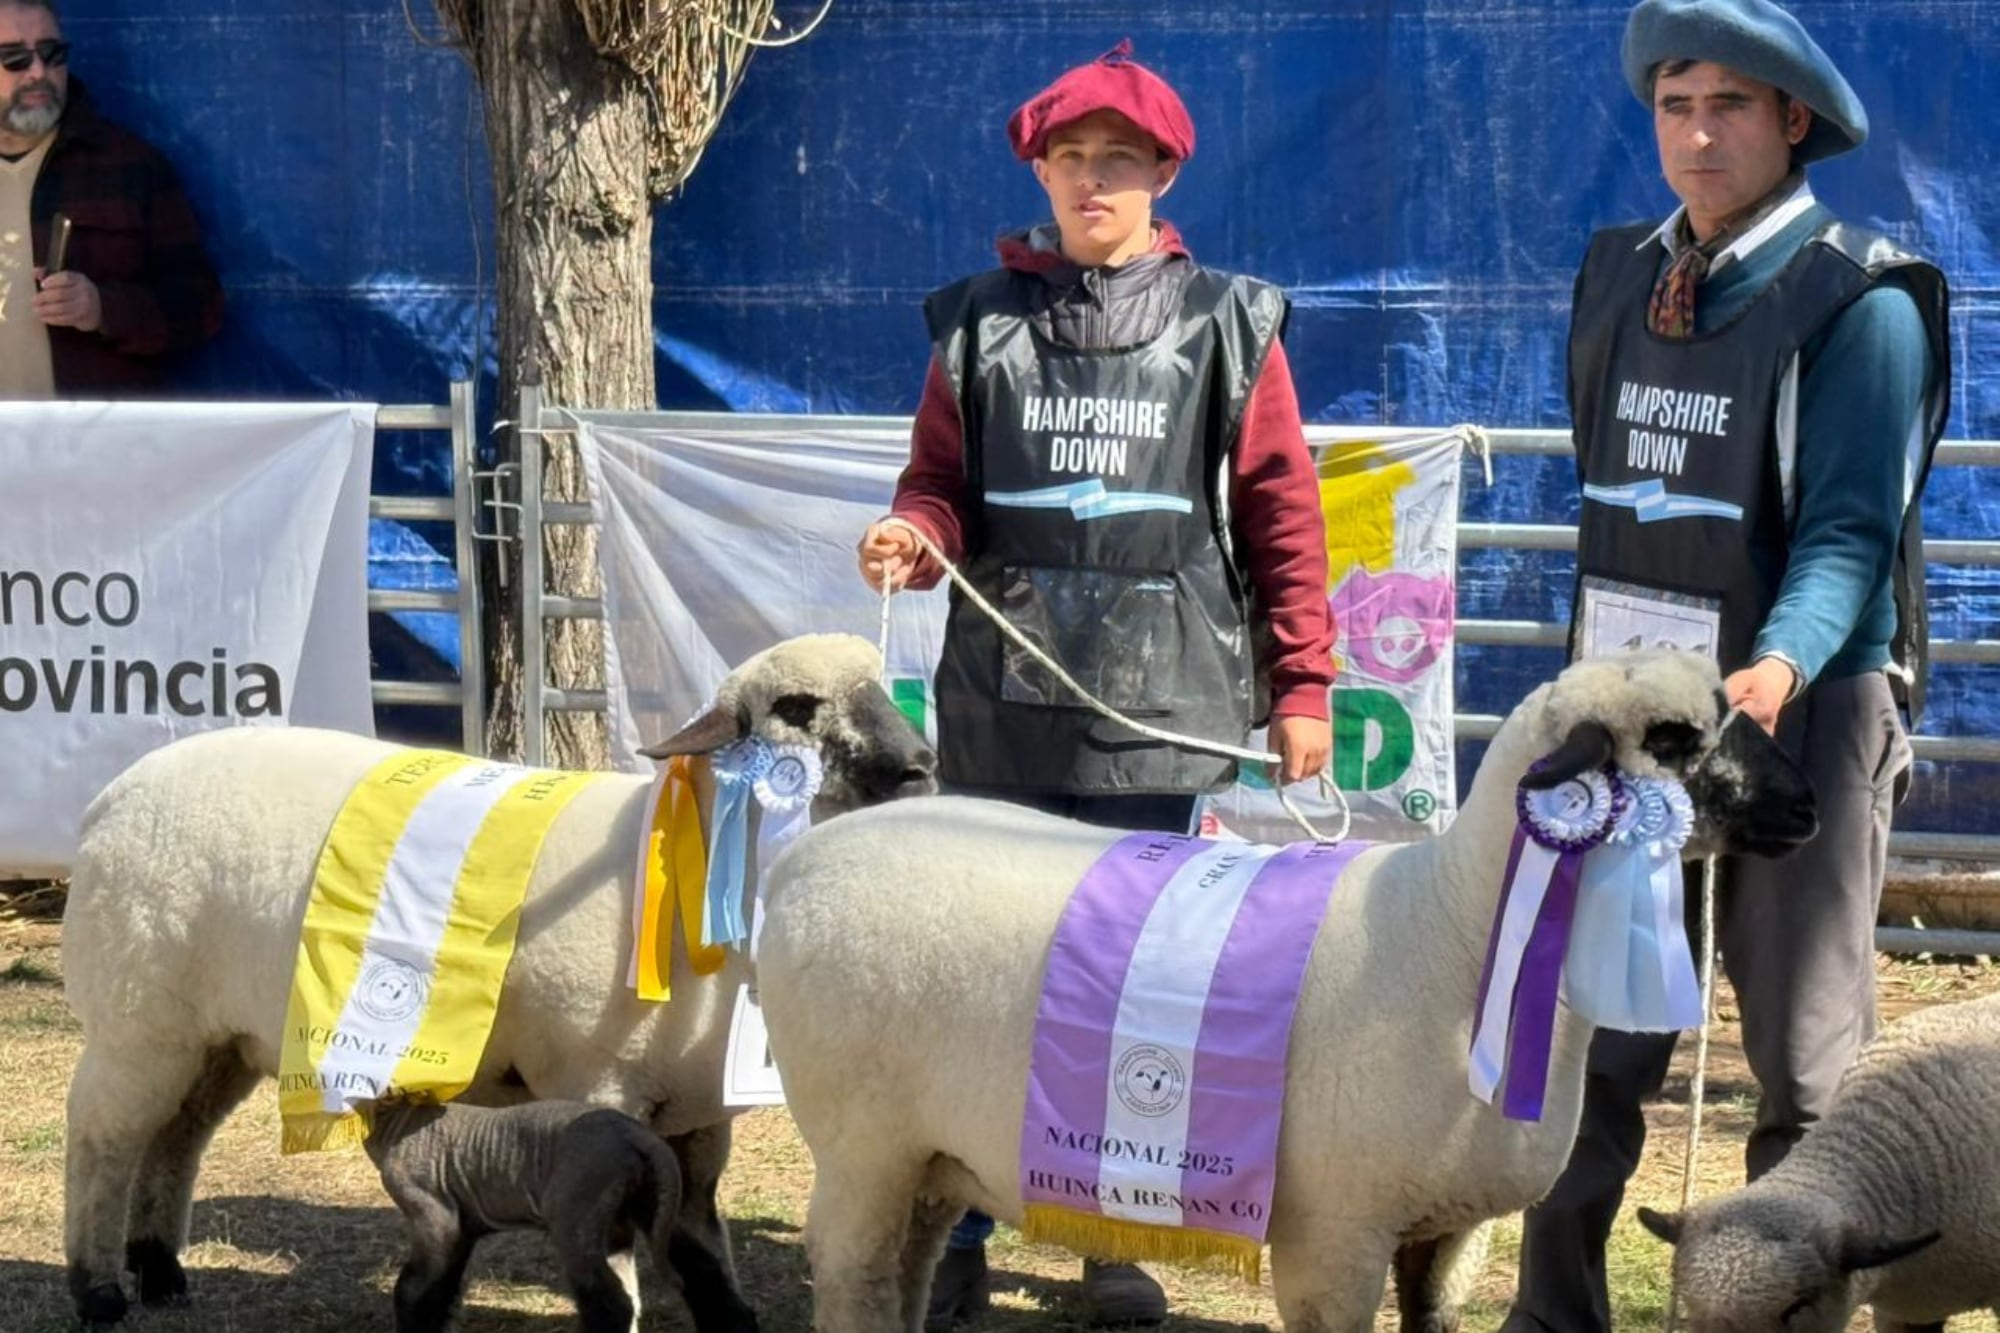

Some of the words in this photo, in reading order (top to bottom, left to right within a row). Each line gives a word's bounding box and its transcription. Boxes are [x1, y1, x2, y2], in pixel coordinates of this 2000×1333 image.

[1022, 396, 1168, 438] HAMPSHIRE
[1616, 381, 1733, 436] HAMPSHIRE
[1050, 437, 1127, 476] DOWN
[1628, 429, 1688, 476] DOWN
[396, 1046, 450, 1066] 2025
[1044, 1126, 1170, 1167] NACIONAL
[1176, 1150, 1235, 1177] 2025
[1029, 1169, 1124, 1205] HUINCA
[1132, 1188, 1221, 1216] RENAN
[1230, 1200, 1264, 1222] CO
